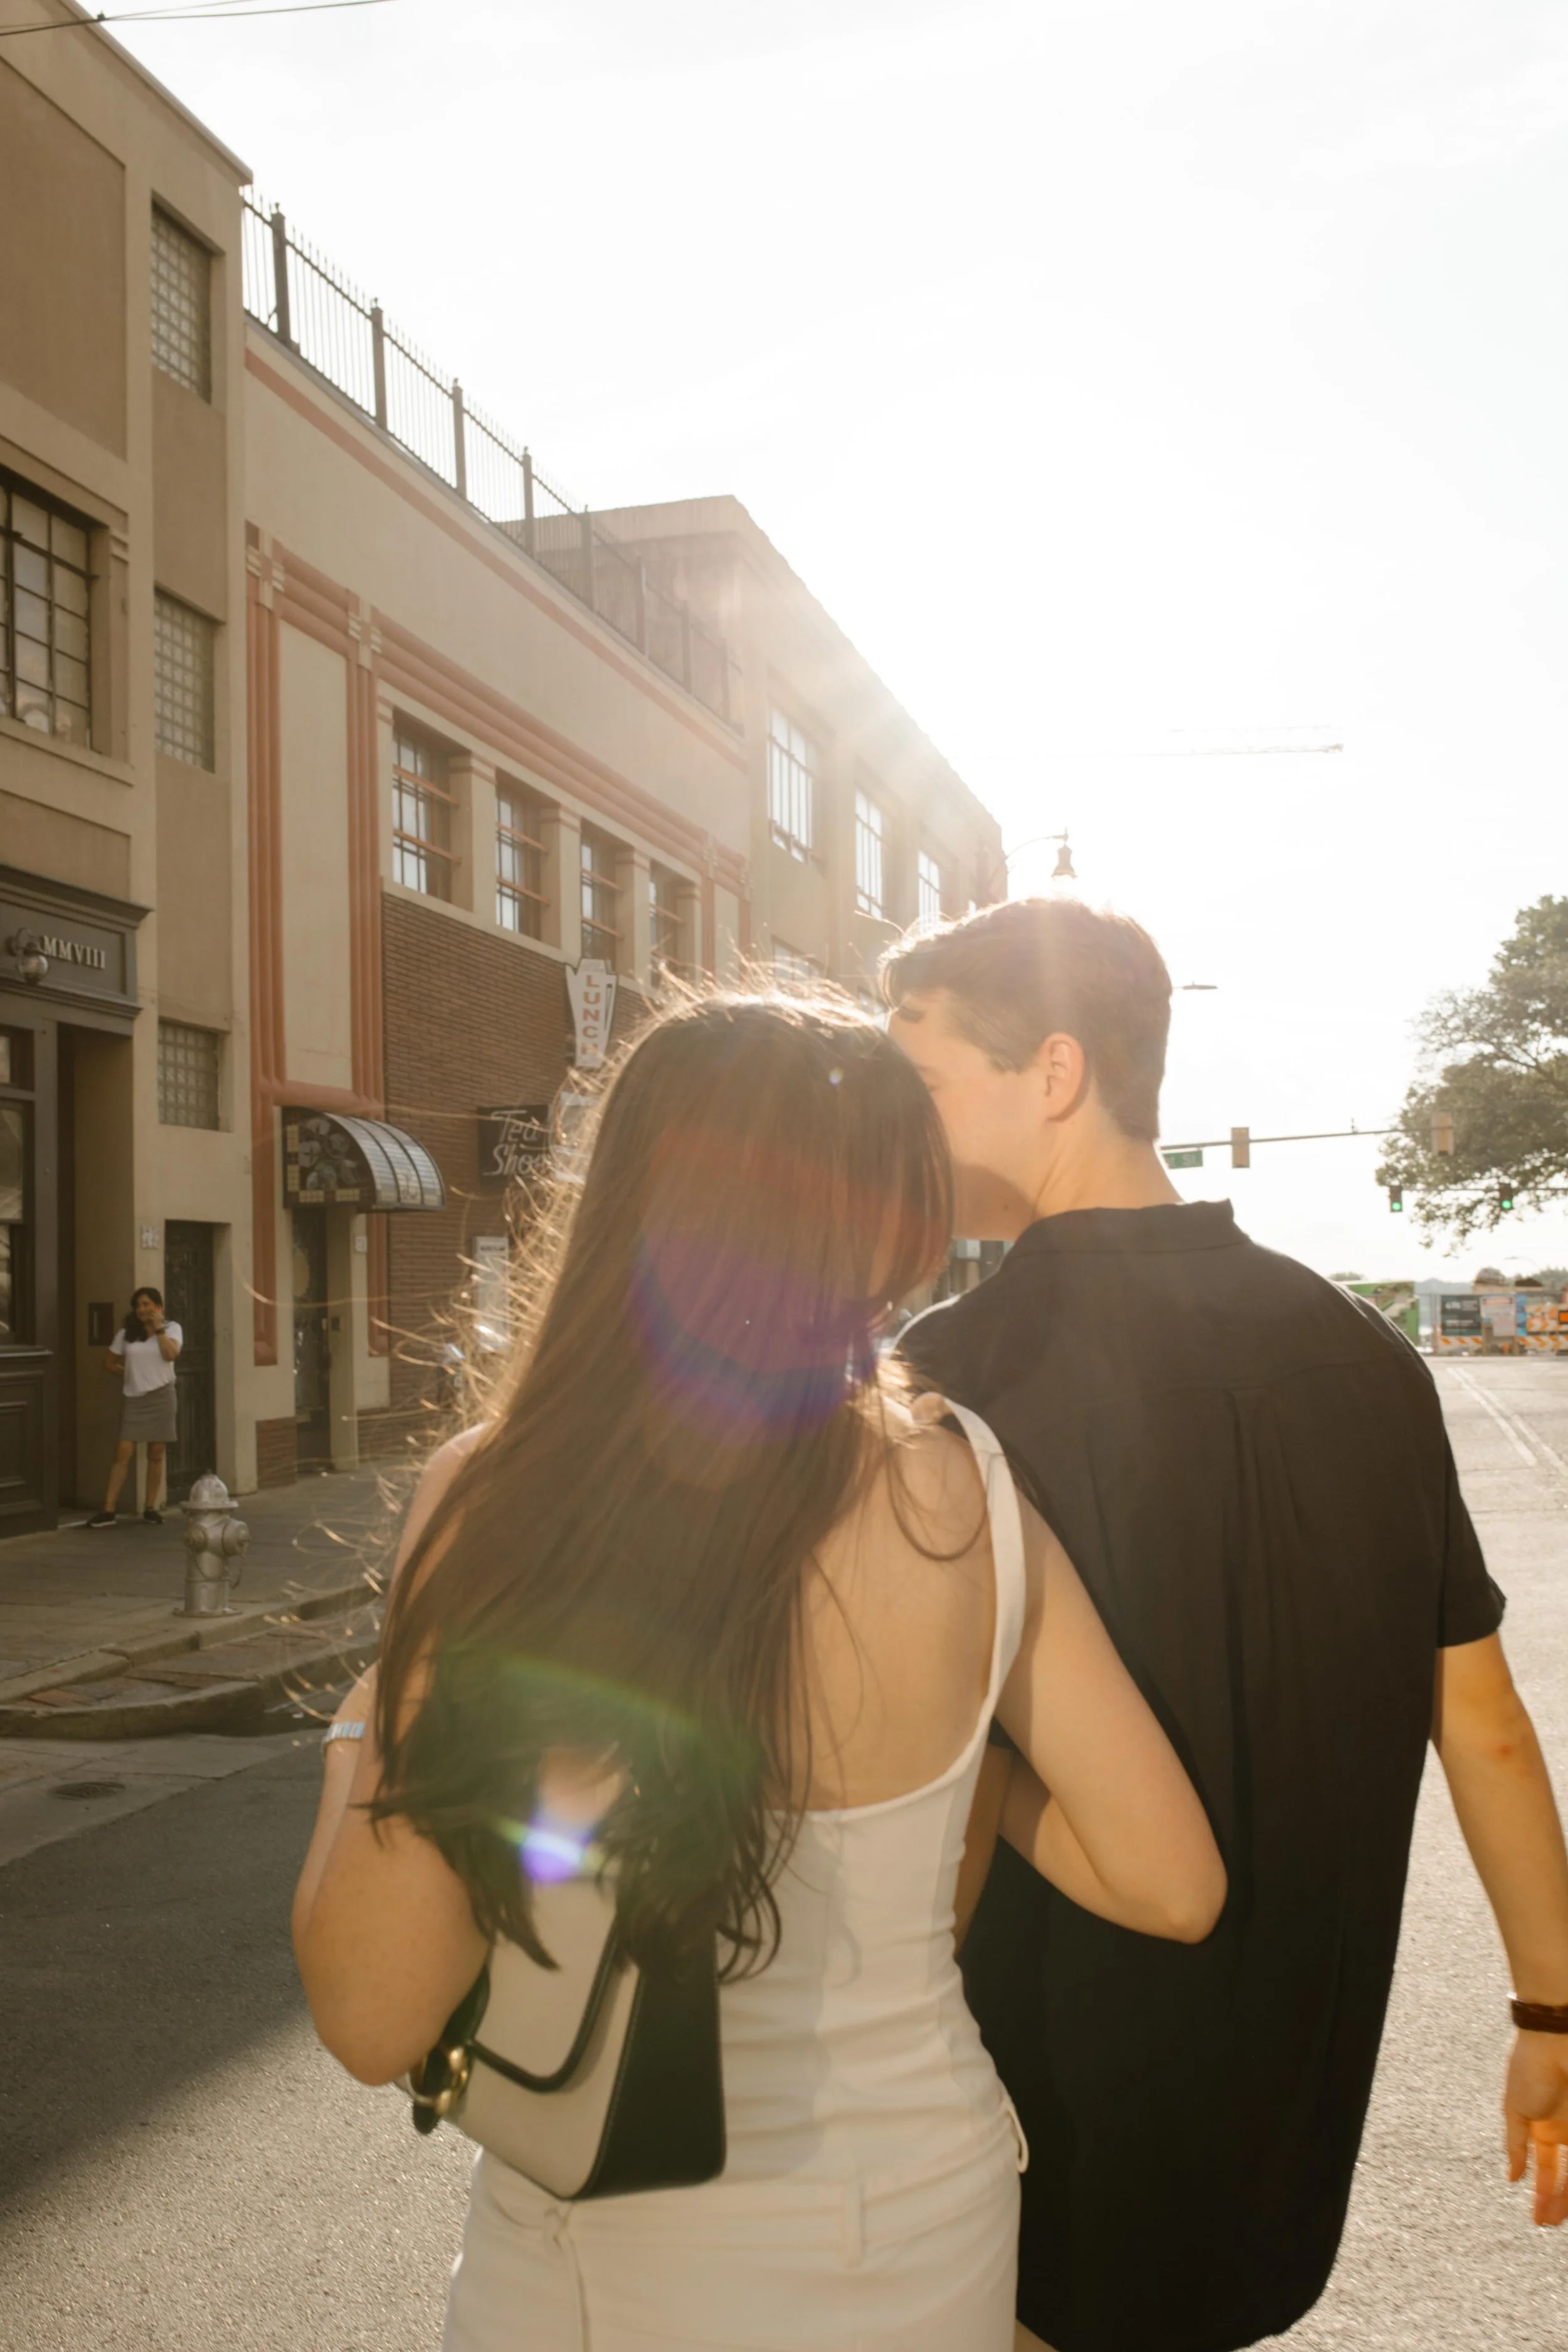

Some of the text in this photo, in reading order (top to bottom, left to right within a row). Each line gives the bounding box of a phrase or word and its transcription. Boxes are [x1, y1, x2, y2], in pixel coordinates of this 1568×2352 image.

[43, 935, 106, 969] MMVIII
[580, 975, 601, 1056] LUNCH
[490, 1109, 539, 1143] Tea
